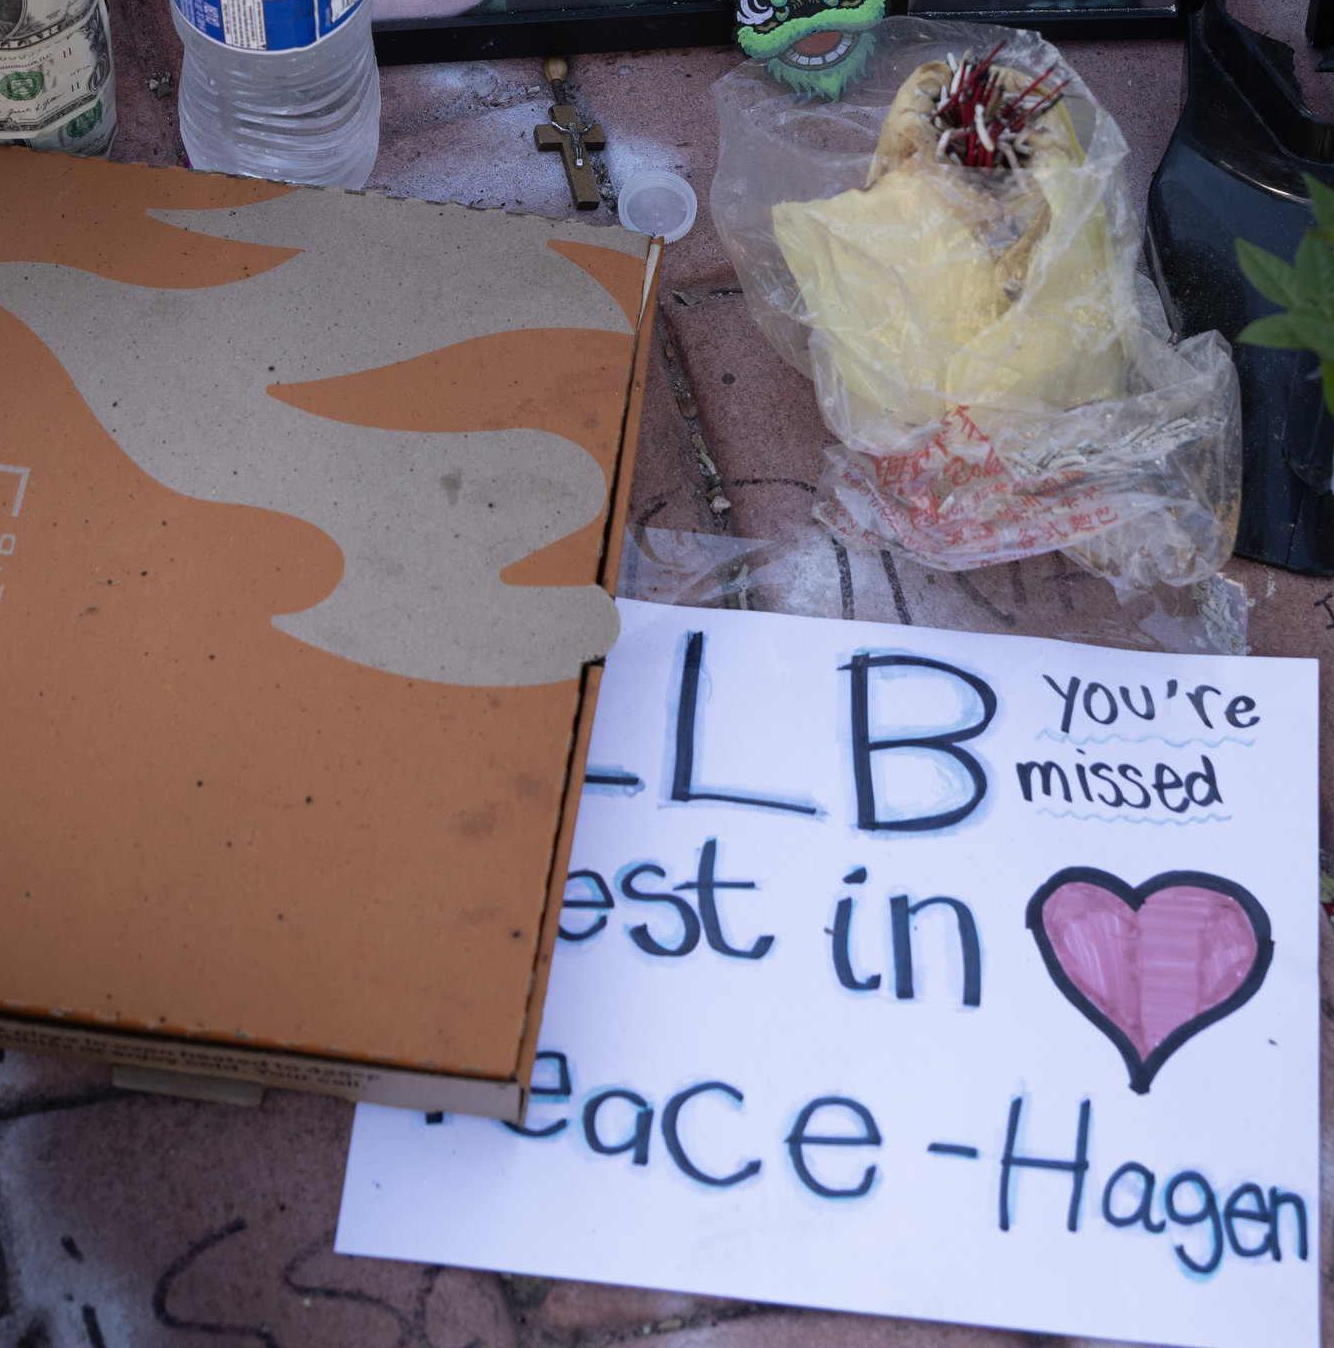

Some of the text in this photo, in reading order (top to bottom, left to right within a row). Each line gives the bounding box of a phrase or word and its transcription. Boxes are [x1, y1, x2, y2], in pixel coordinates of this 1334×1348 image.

[1042, 671, 1260, 738] you're
[1014, 753, 1224, 814] missed
[555, 838, 984, 1009] est in
[425, 1050, 885, 1199] eace
